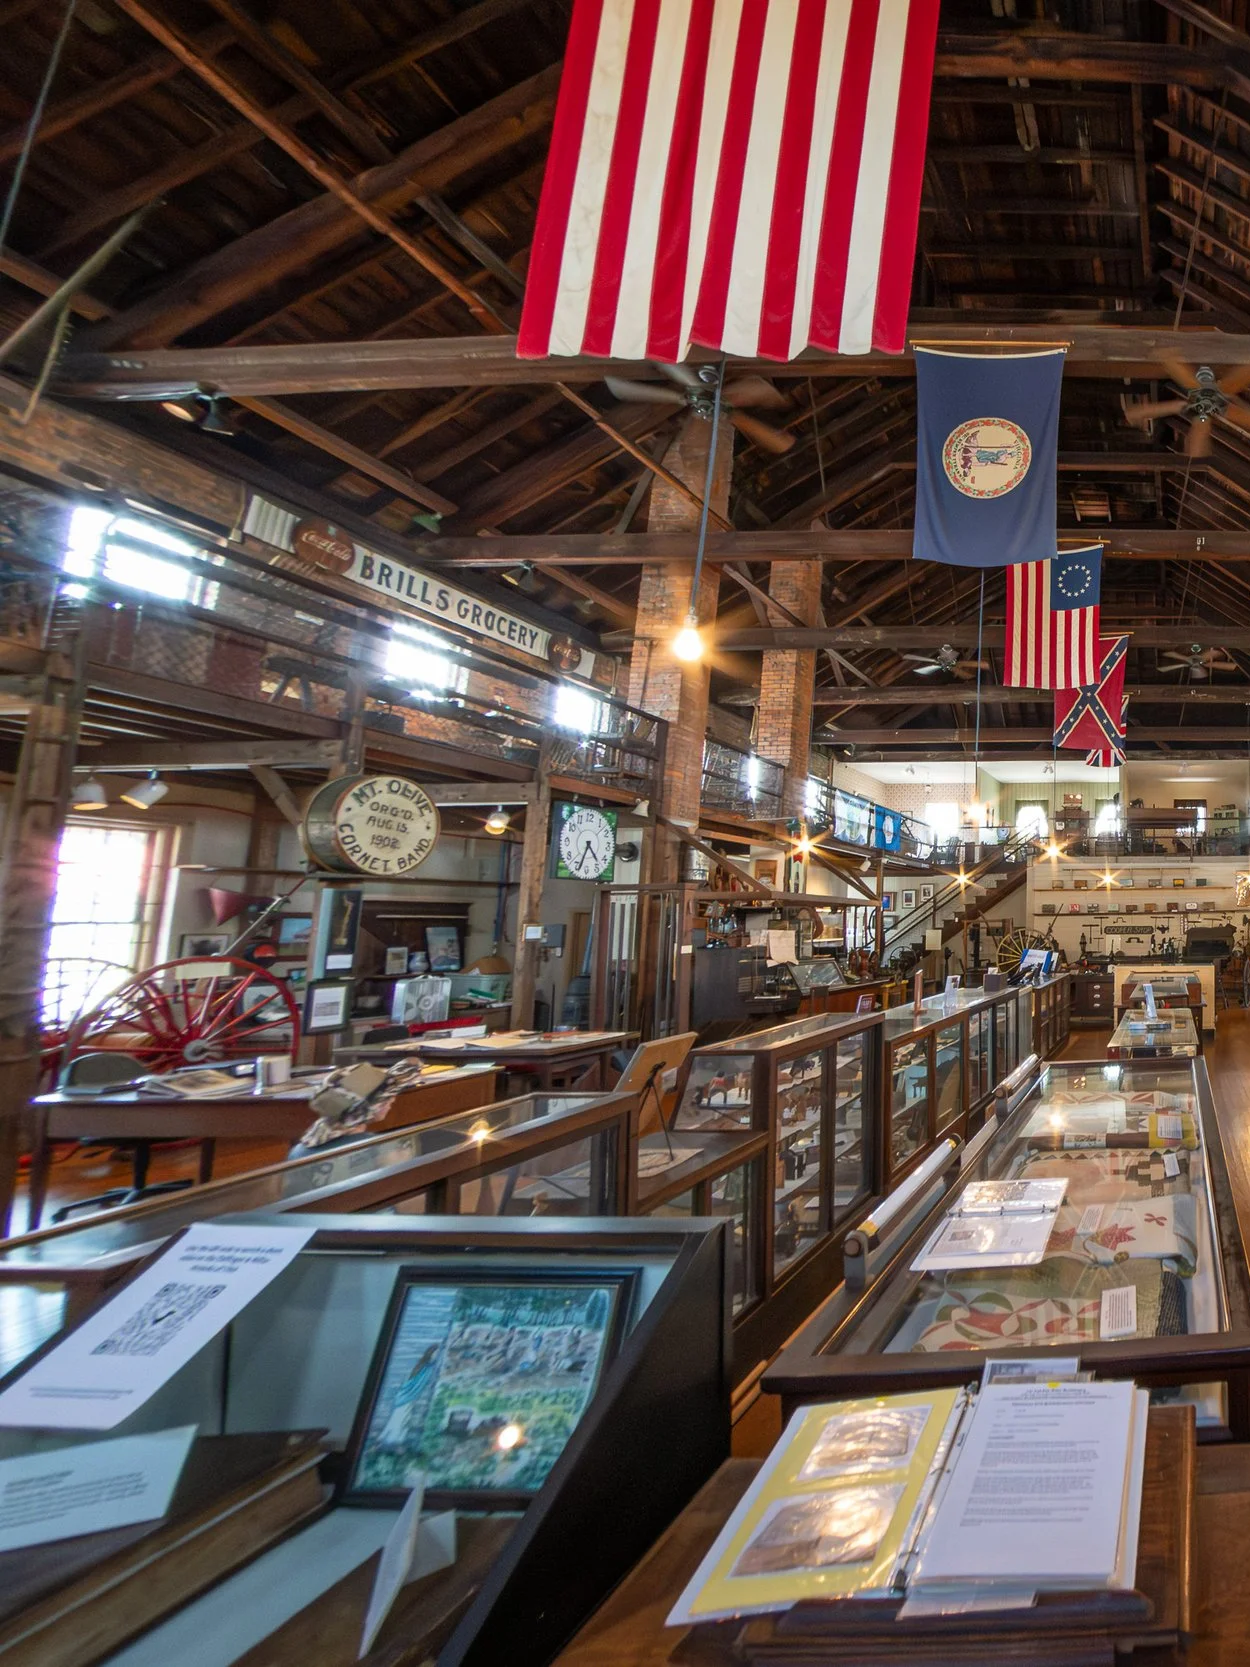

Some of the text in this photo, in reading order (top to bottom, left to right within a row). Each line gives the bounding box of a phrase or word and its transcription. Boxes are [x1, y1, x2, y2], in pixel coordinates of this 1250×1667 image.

[1013, 439, 1021, 470] VIRGINIA
[360, 555, 539, 650] BRILLS GROCERY
[351, 780, 433, 817] MT. OLIVE
[366, 815, 392, 830] AUG
[586, 812, 594, 823] 12
[568, 822, 576, 832] 10
[603, 829, 609, 838] 2
[370, 834, 401, 850] 1902
[564, 836, 570, 847] 9
[605, 842, 611, 852] 3
[339, 823, 392, 872] CORNET
[566, 851, 572, 861] 8
[601, 854, 608, 864] 4
[574, 860, 580, 871] 7
[584, 865, 589, 875] 6
[594, 863, 600, 873] 5
